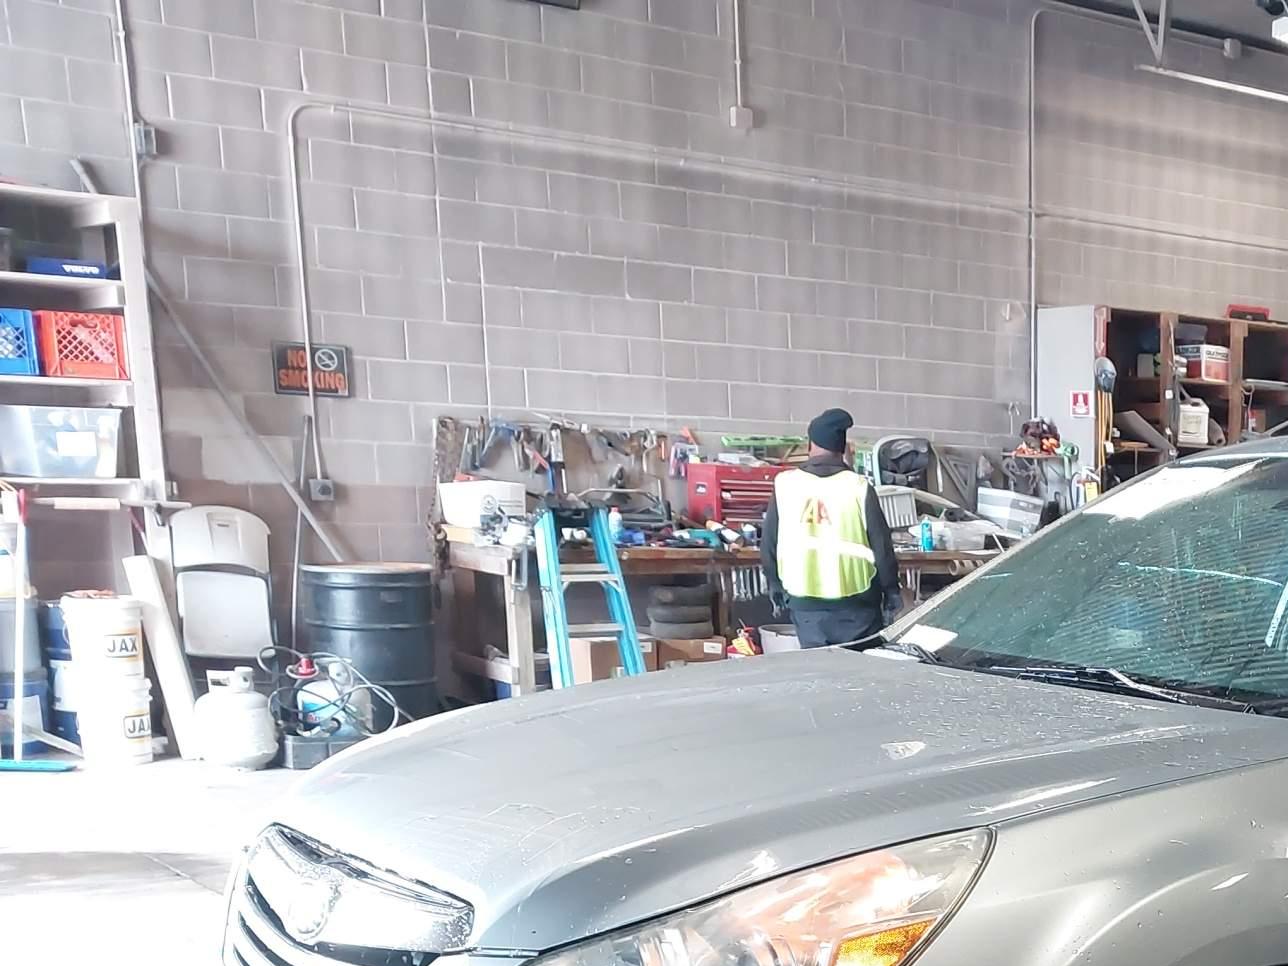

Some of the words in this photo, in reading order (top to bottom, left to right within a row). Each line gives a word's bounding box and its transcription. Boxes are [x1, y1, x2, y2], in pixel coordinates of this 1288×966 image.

[288, 348, 307, 369] NO
[279, 368, 345, 389] SMOKING
[106, 636, 138, 653] JAX
